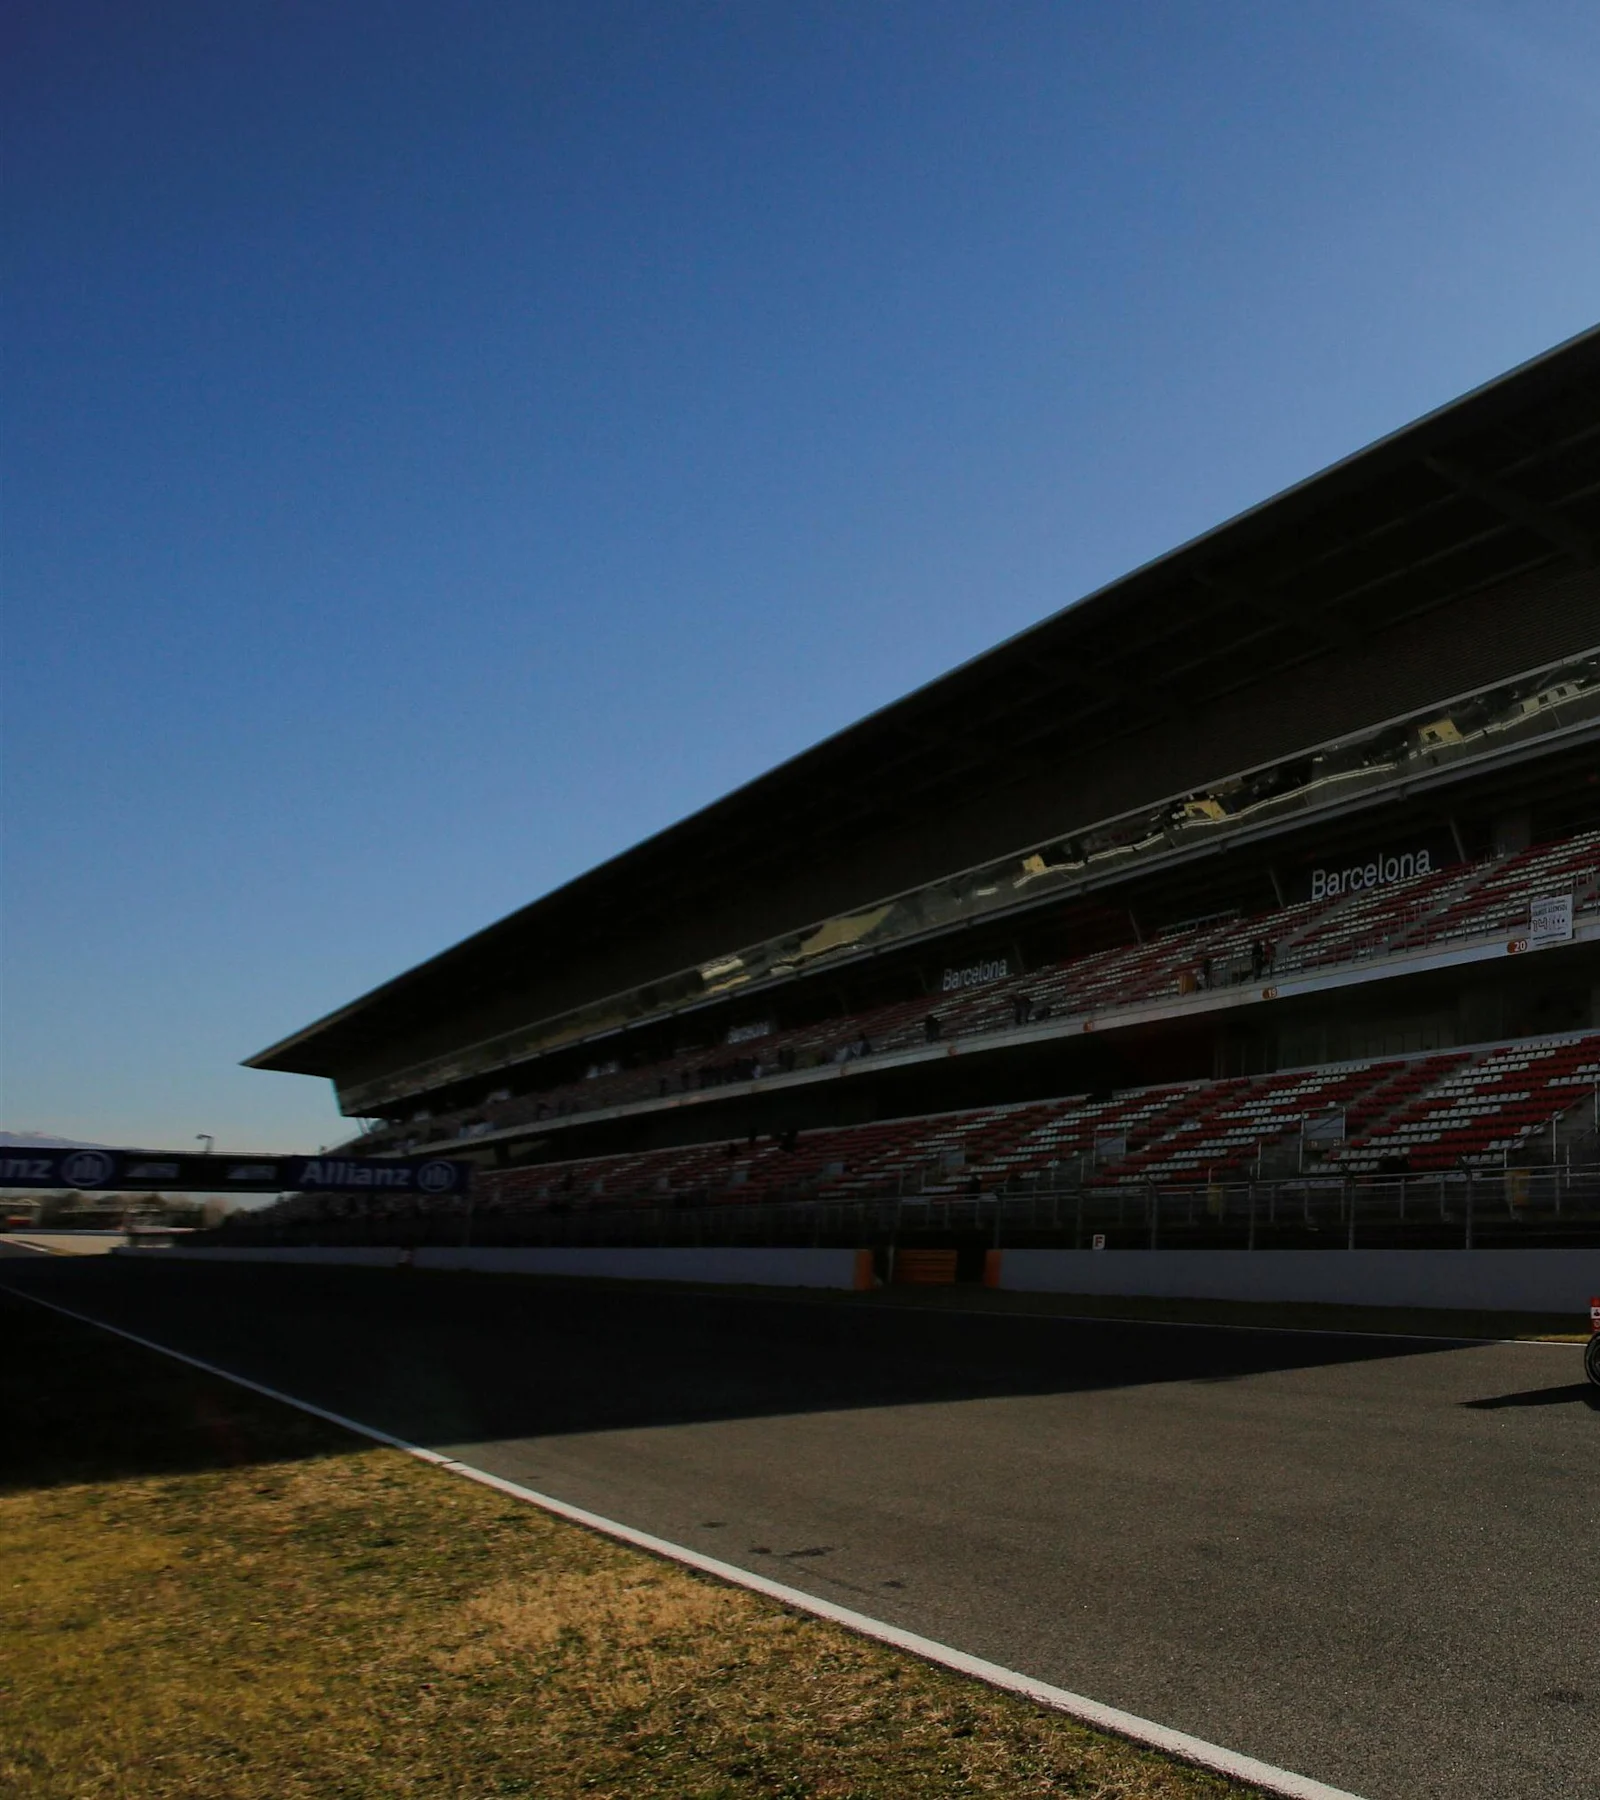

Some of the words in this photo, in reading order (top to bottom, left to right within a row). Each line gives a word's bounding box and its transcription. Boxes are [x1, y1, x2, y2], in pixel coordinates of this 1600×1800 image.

[1311, 849, 1431, 900] Barcelona
[1514, 941, 1526, 952] 20
[942, 958, 1008, 991] Barcelona
[299, 1161, 412, 1185] Allianz
